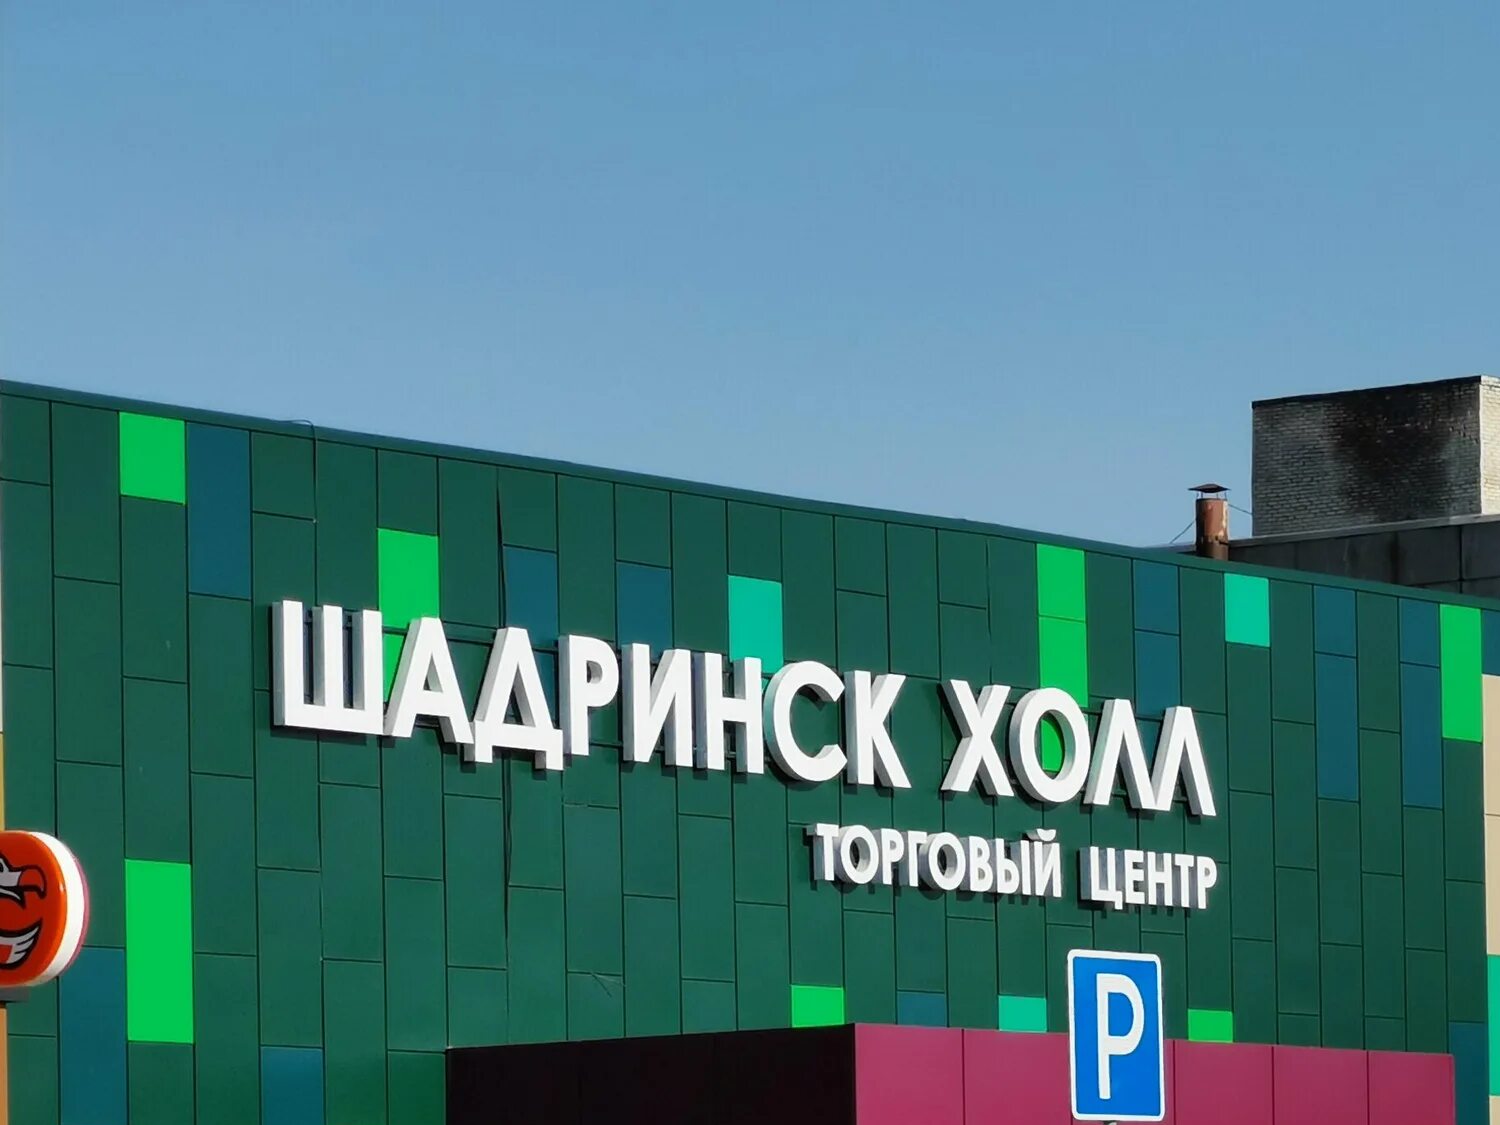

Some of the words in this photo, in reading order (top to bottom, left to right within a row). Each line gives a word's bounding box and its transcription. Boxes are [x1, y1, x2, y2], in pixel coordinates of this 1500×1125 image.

[275, 599, 912, 788] ШАДРИНСК
[944, 678, 1216, 817] ХОЛЛ
[812, 822, 1064, 898] ТОРГОВЫЙ
[1085, 845, 1219, 911] ЦЕНТР
[1096, 973, 1145, 1100] P
